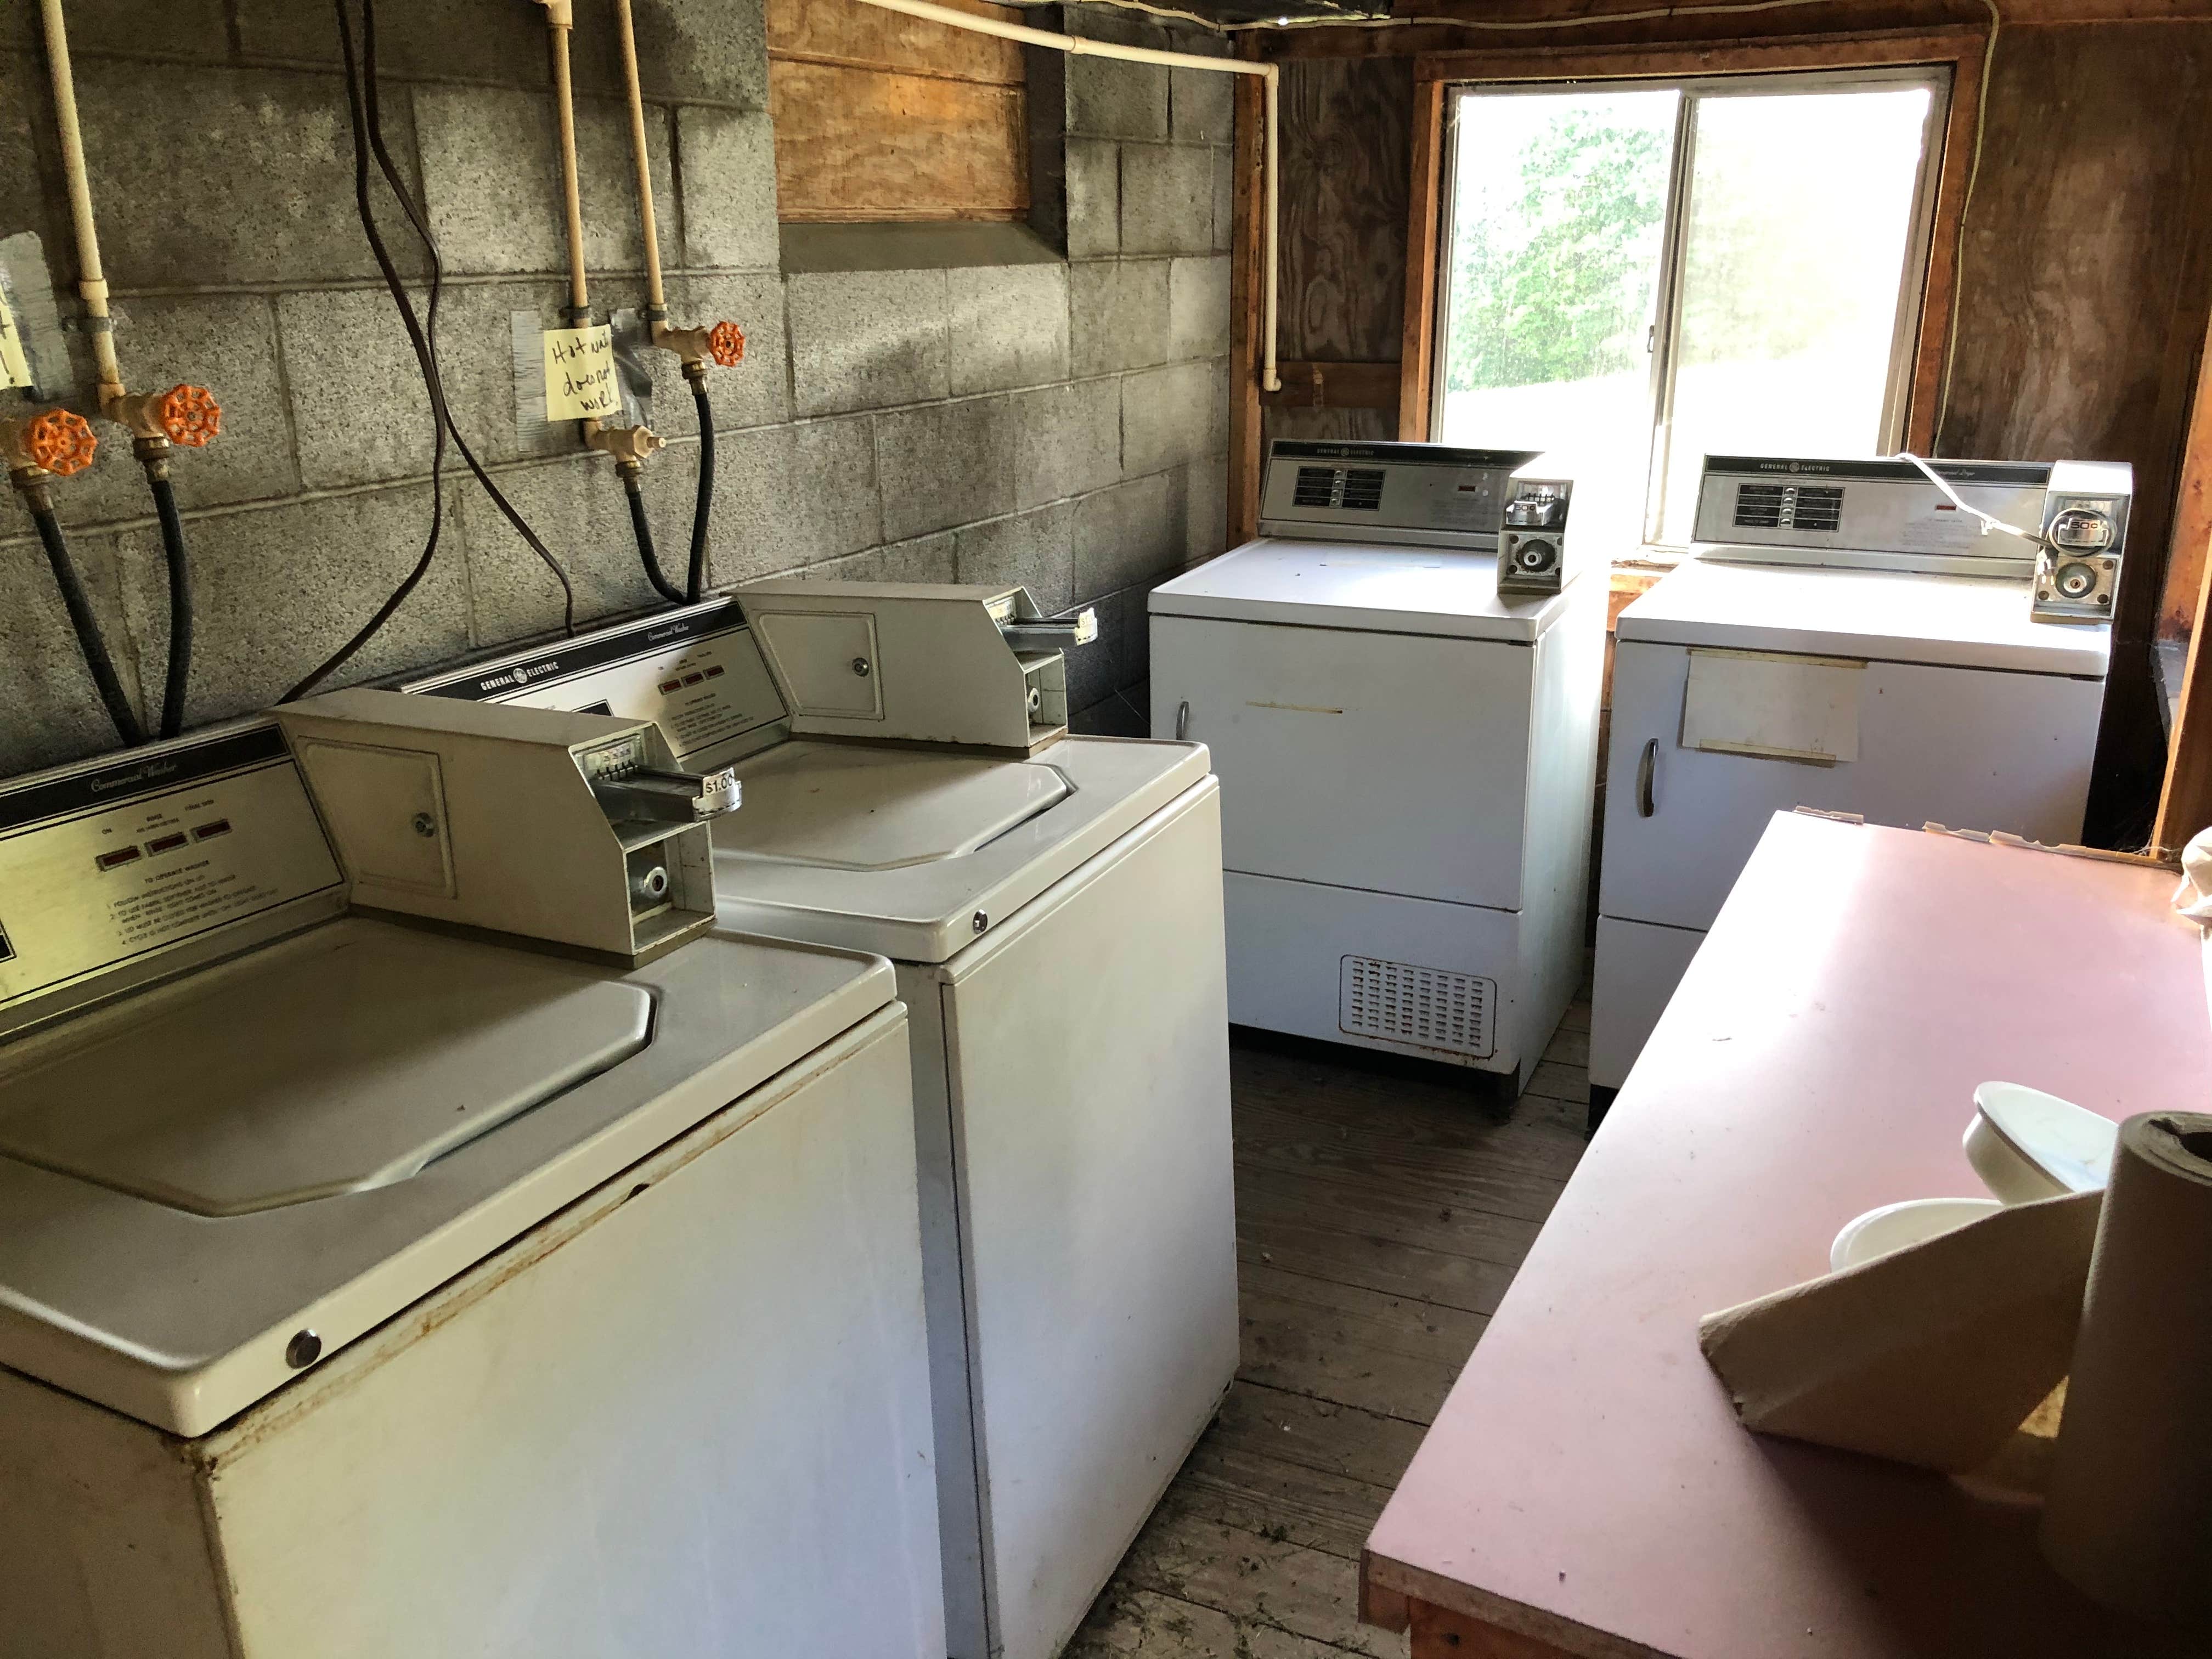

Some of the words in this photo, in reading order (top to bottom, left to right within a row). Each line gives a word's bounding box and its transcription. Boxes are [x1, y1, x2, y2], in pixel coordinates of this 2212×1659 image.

[552, 336, 586, 364] Hot
[563, 372, 595, 396] does
[596, 360, 610, 383] not
[2070, 521, 2098, 529] 50¢
[480, 674, 515, 691] GENERAL
[527, 661, 559, 678] ELECTRIC
[91, 768, 142, 792] Commercial
[706, 773, 733, 793] $1.00
